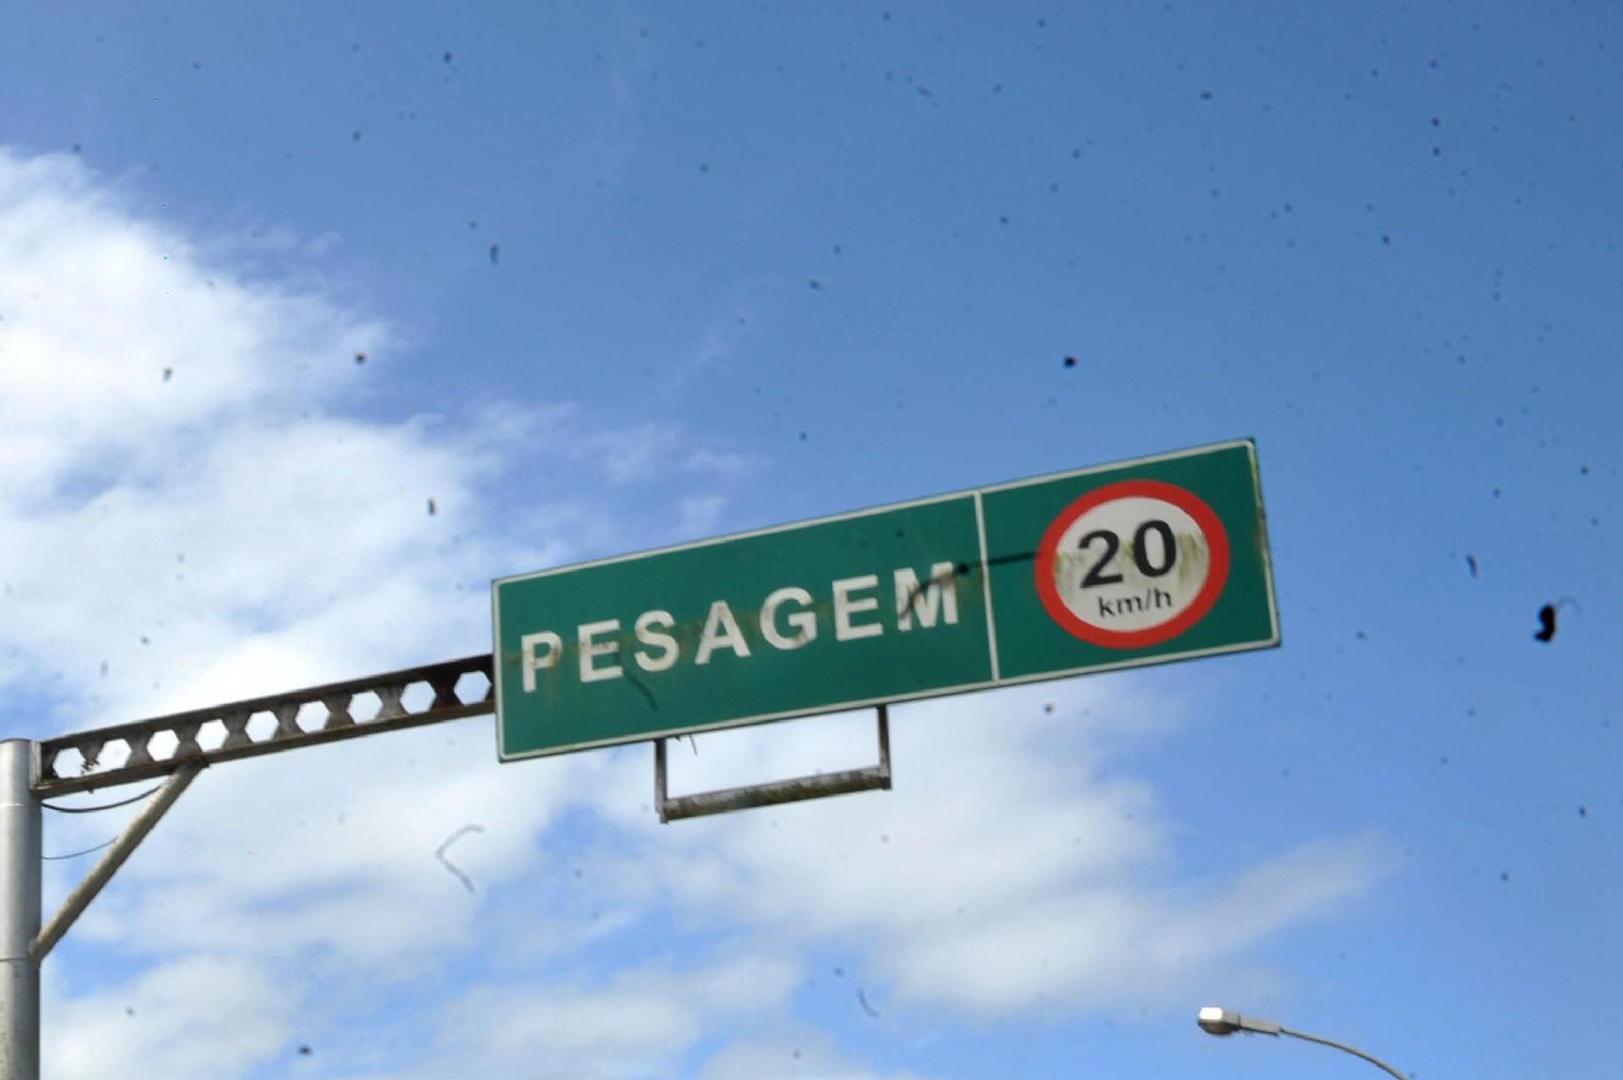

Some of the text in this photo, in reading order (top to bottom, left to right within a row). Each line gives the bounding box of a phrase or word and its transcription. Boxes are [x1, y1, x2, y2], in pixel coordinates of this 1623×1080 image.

[1078, 519, 1177, 589] 20
[520, 560, 960, 693] PESAGEM
[1097, 587, 1173, 618] km/h
